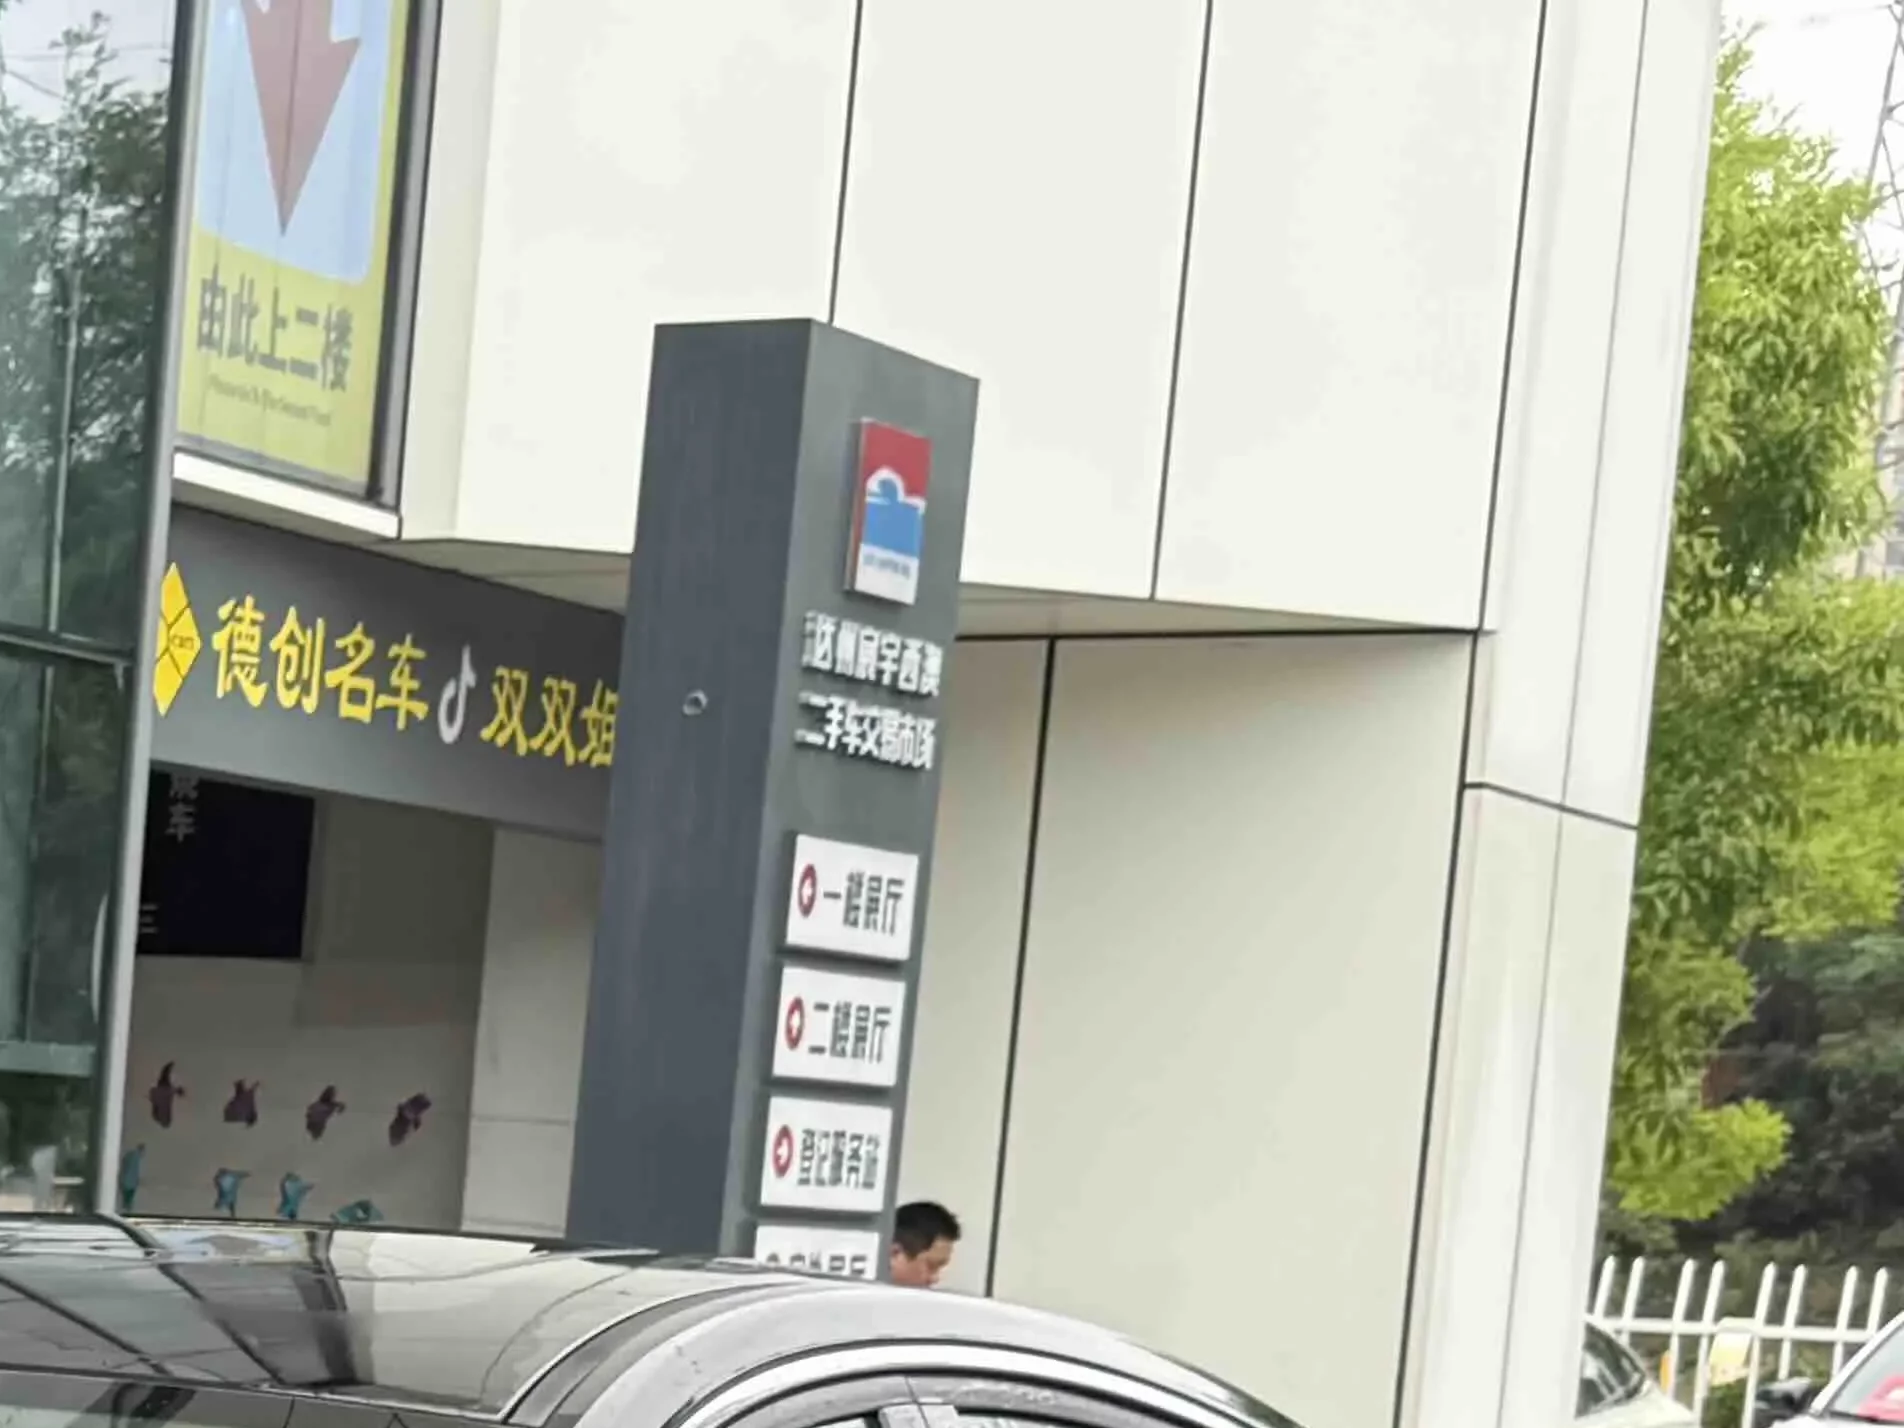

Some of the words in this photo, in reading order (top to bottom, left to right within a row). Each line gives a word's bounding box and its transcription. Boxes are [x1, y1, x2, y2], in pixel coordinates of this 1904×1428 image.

[197, 262, 353, 393] 由此上二楼
[210, 593, 429, 732] 德创名车
[794, 690, 938, 773] 二手车交易市场
[822, 870, 906, 936] 一楼展厅
[808, 1000, 894, 1065] 二楼展厅
